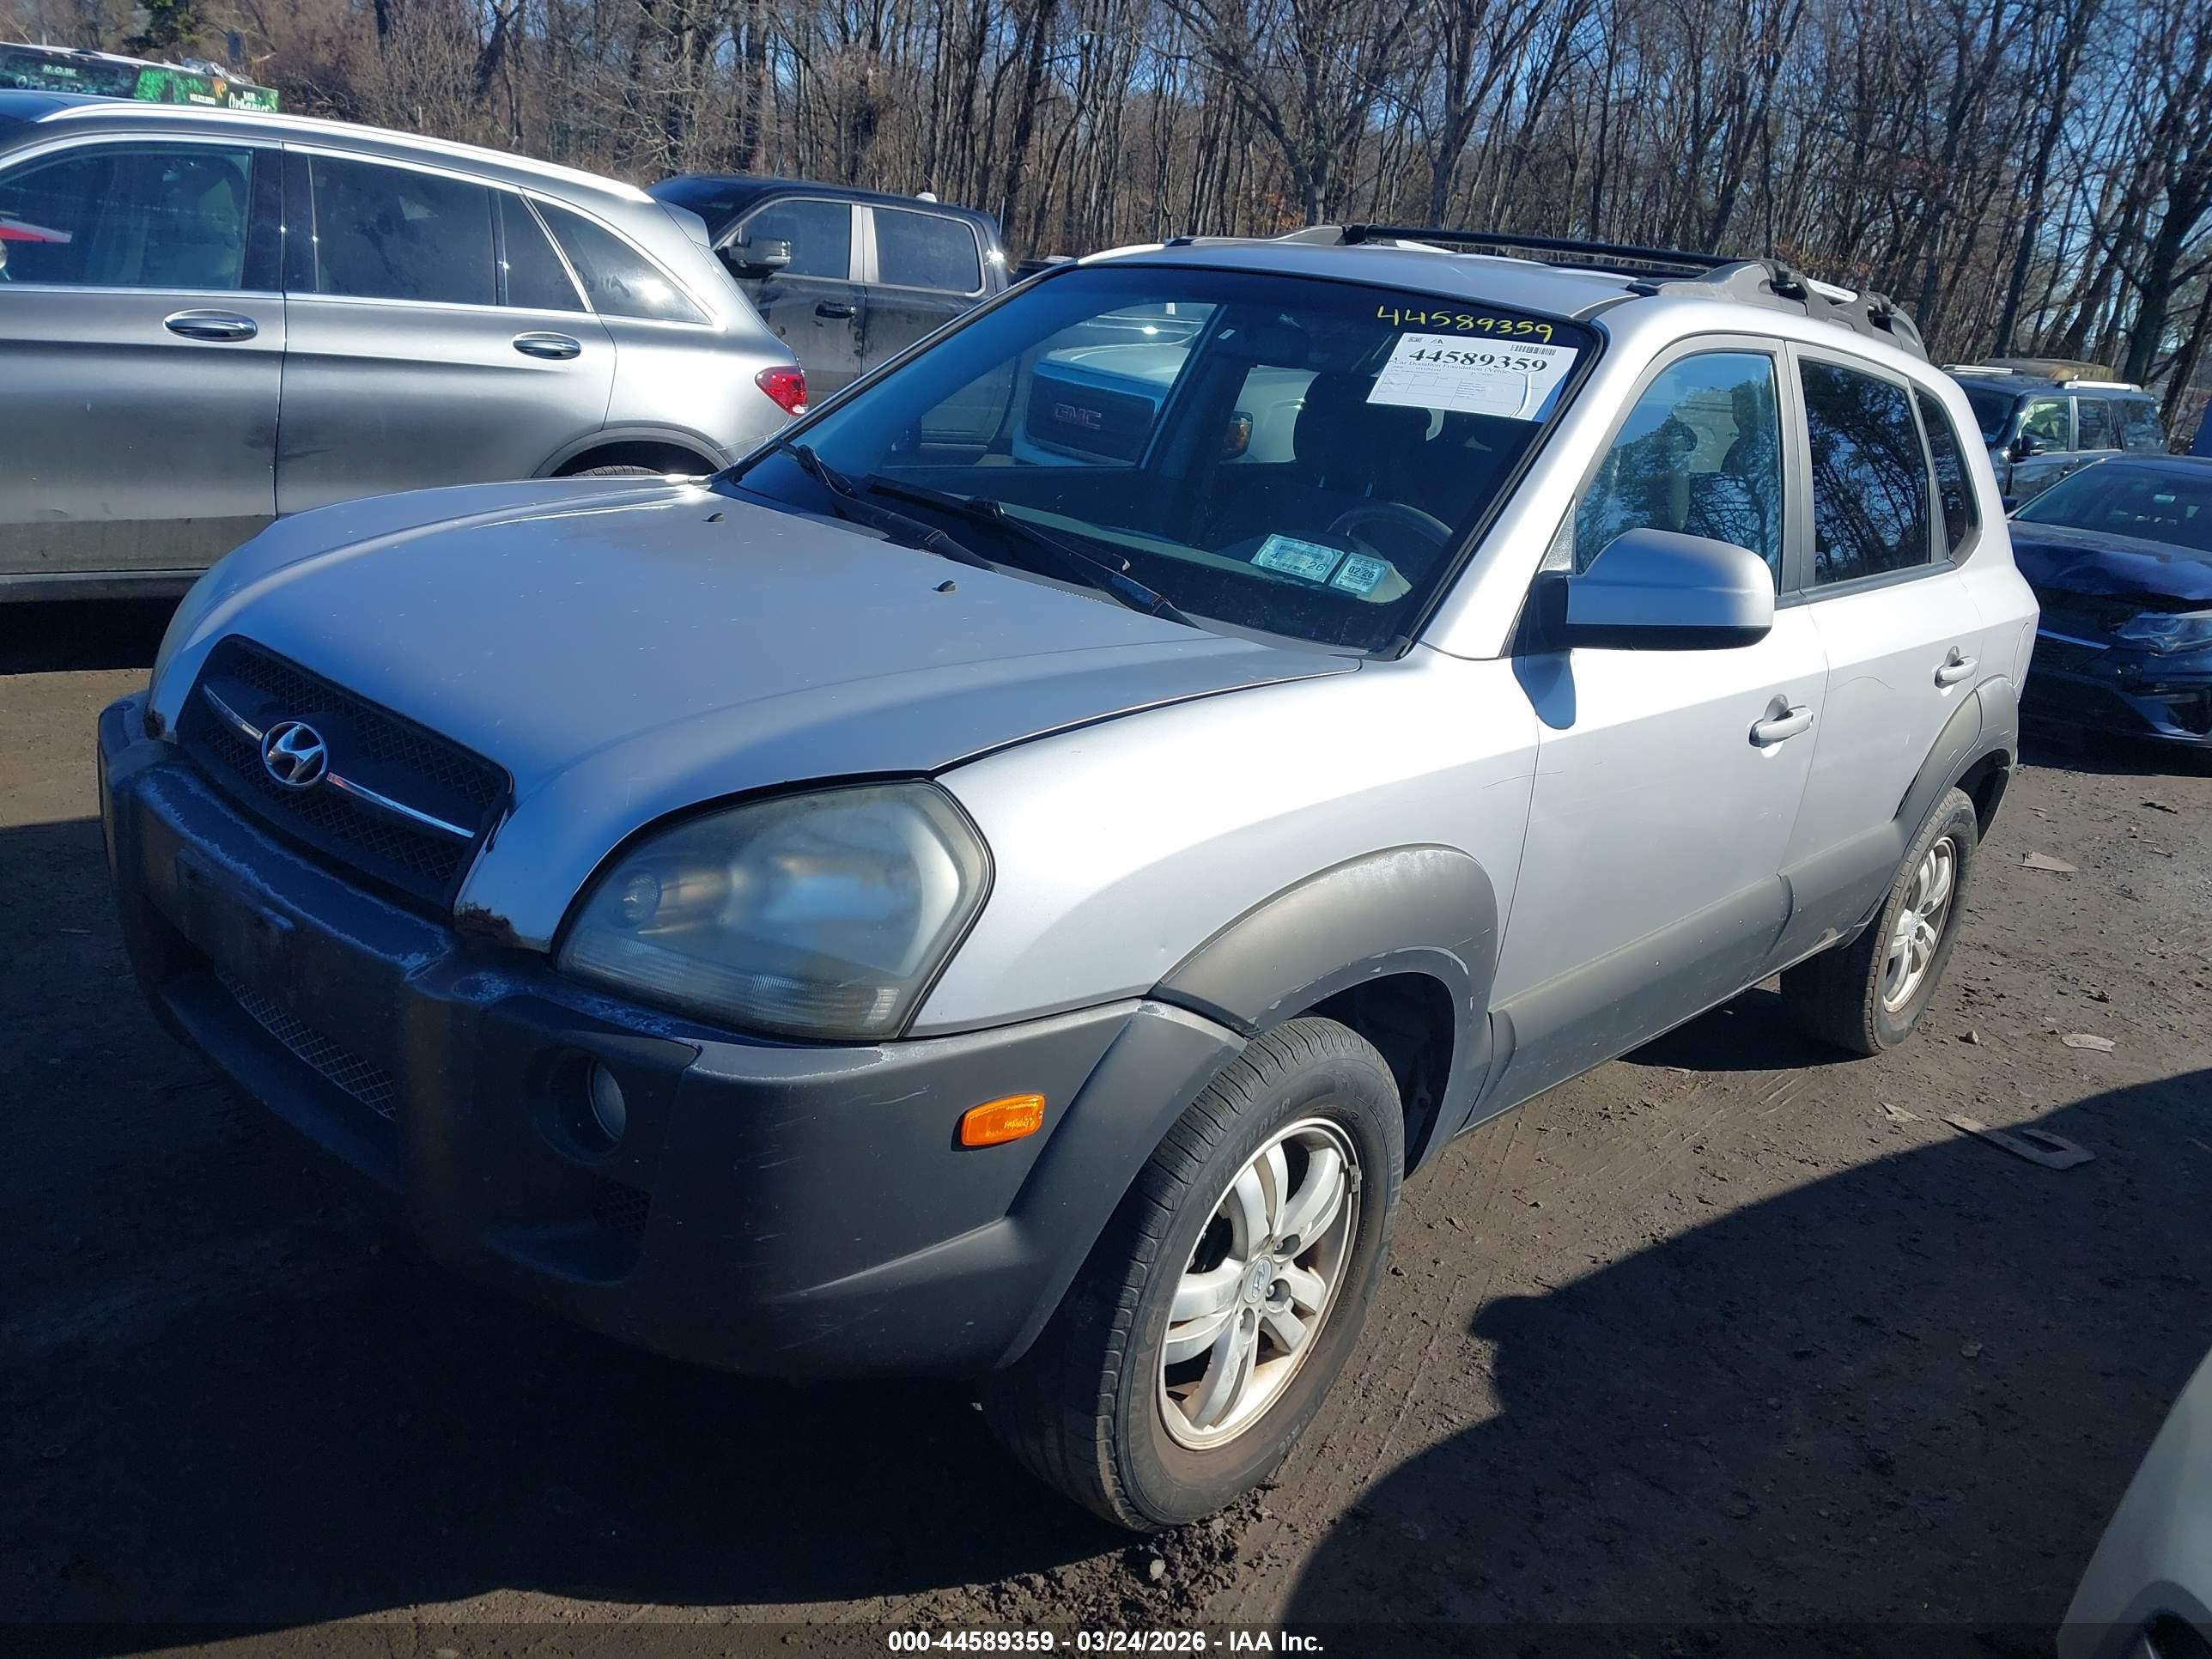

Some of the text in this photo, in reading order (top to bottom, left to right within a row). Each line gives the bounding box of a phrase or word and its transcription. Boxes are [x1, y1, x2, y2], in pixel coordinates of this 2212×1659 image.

[1377, 306, 1553, 343] 44589359
[1408, 348, 1548, 373] 44589359
[1054, 402, 1103, 430] GMC
[1307, 561, 1328, 572] 26
